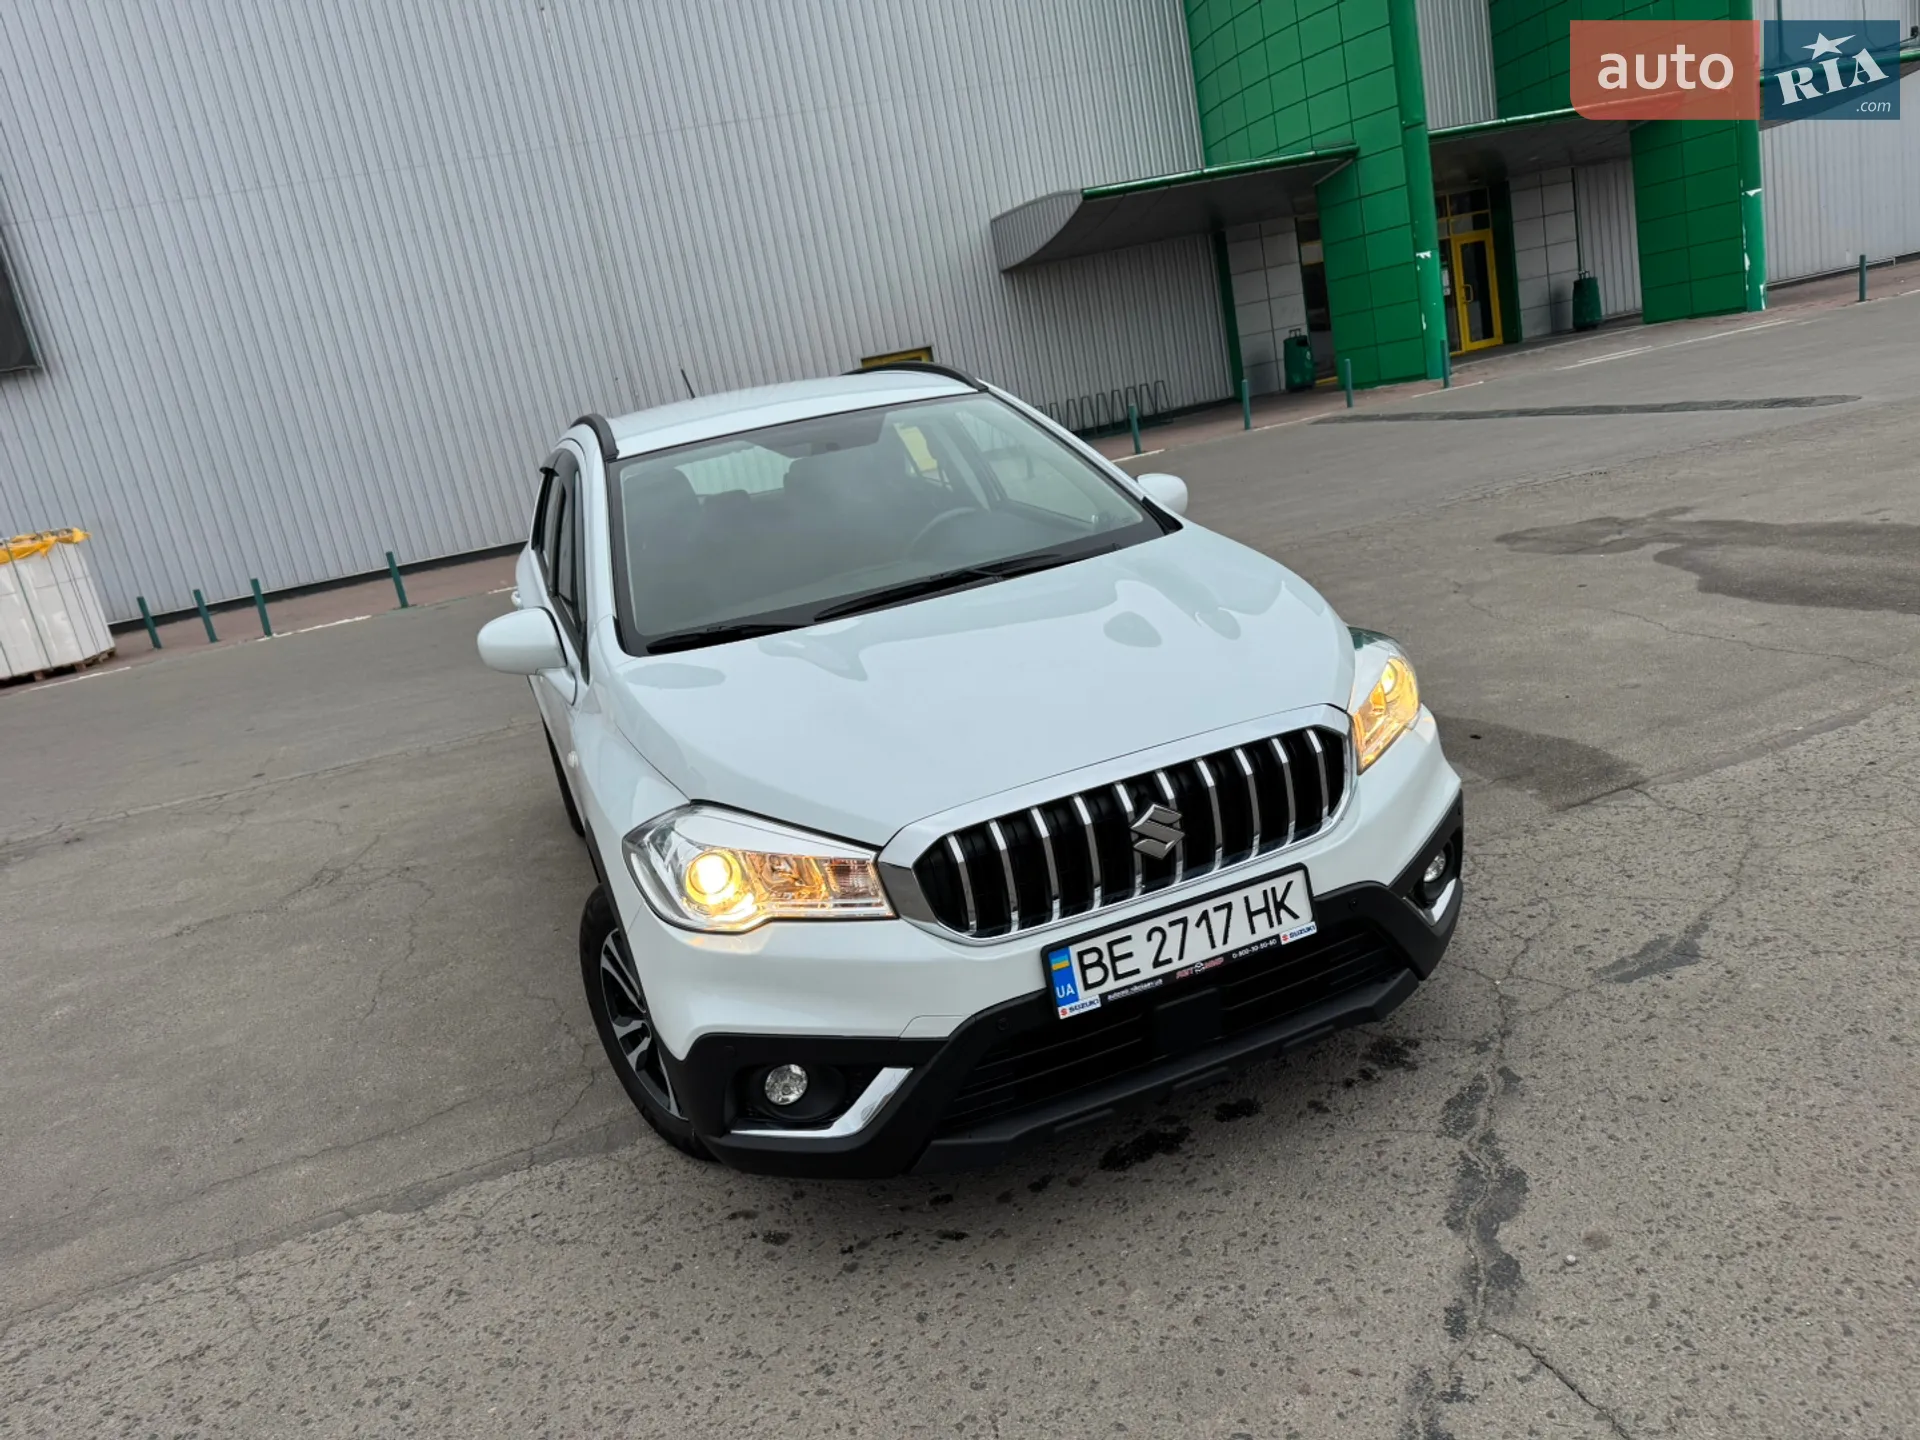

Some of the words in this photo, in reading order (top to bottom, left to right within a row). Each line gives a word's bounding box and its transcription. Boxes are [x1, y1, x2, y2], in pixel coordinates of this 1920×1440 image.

[1077, 935, 1141, 992] BE
[1146, 901, 1233, 969] 2717
[1244, 880, 1300, 935] HK
[1288, 922, 1317, 939] SUZUKI
[1056, 983, 1076, 998] UA
[1068, 998, 1100, 1014] SUZUKI
